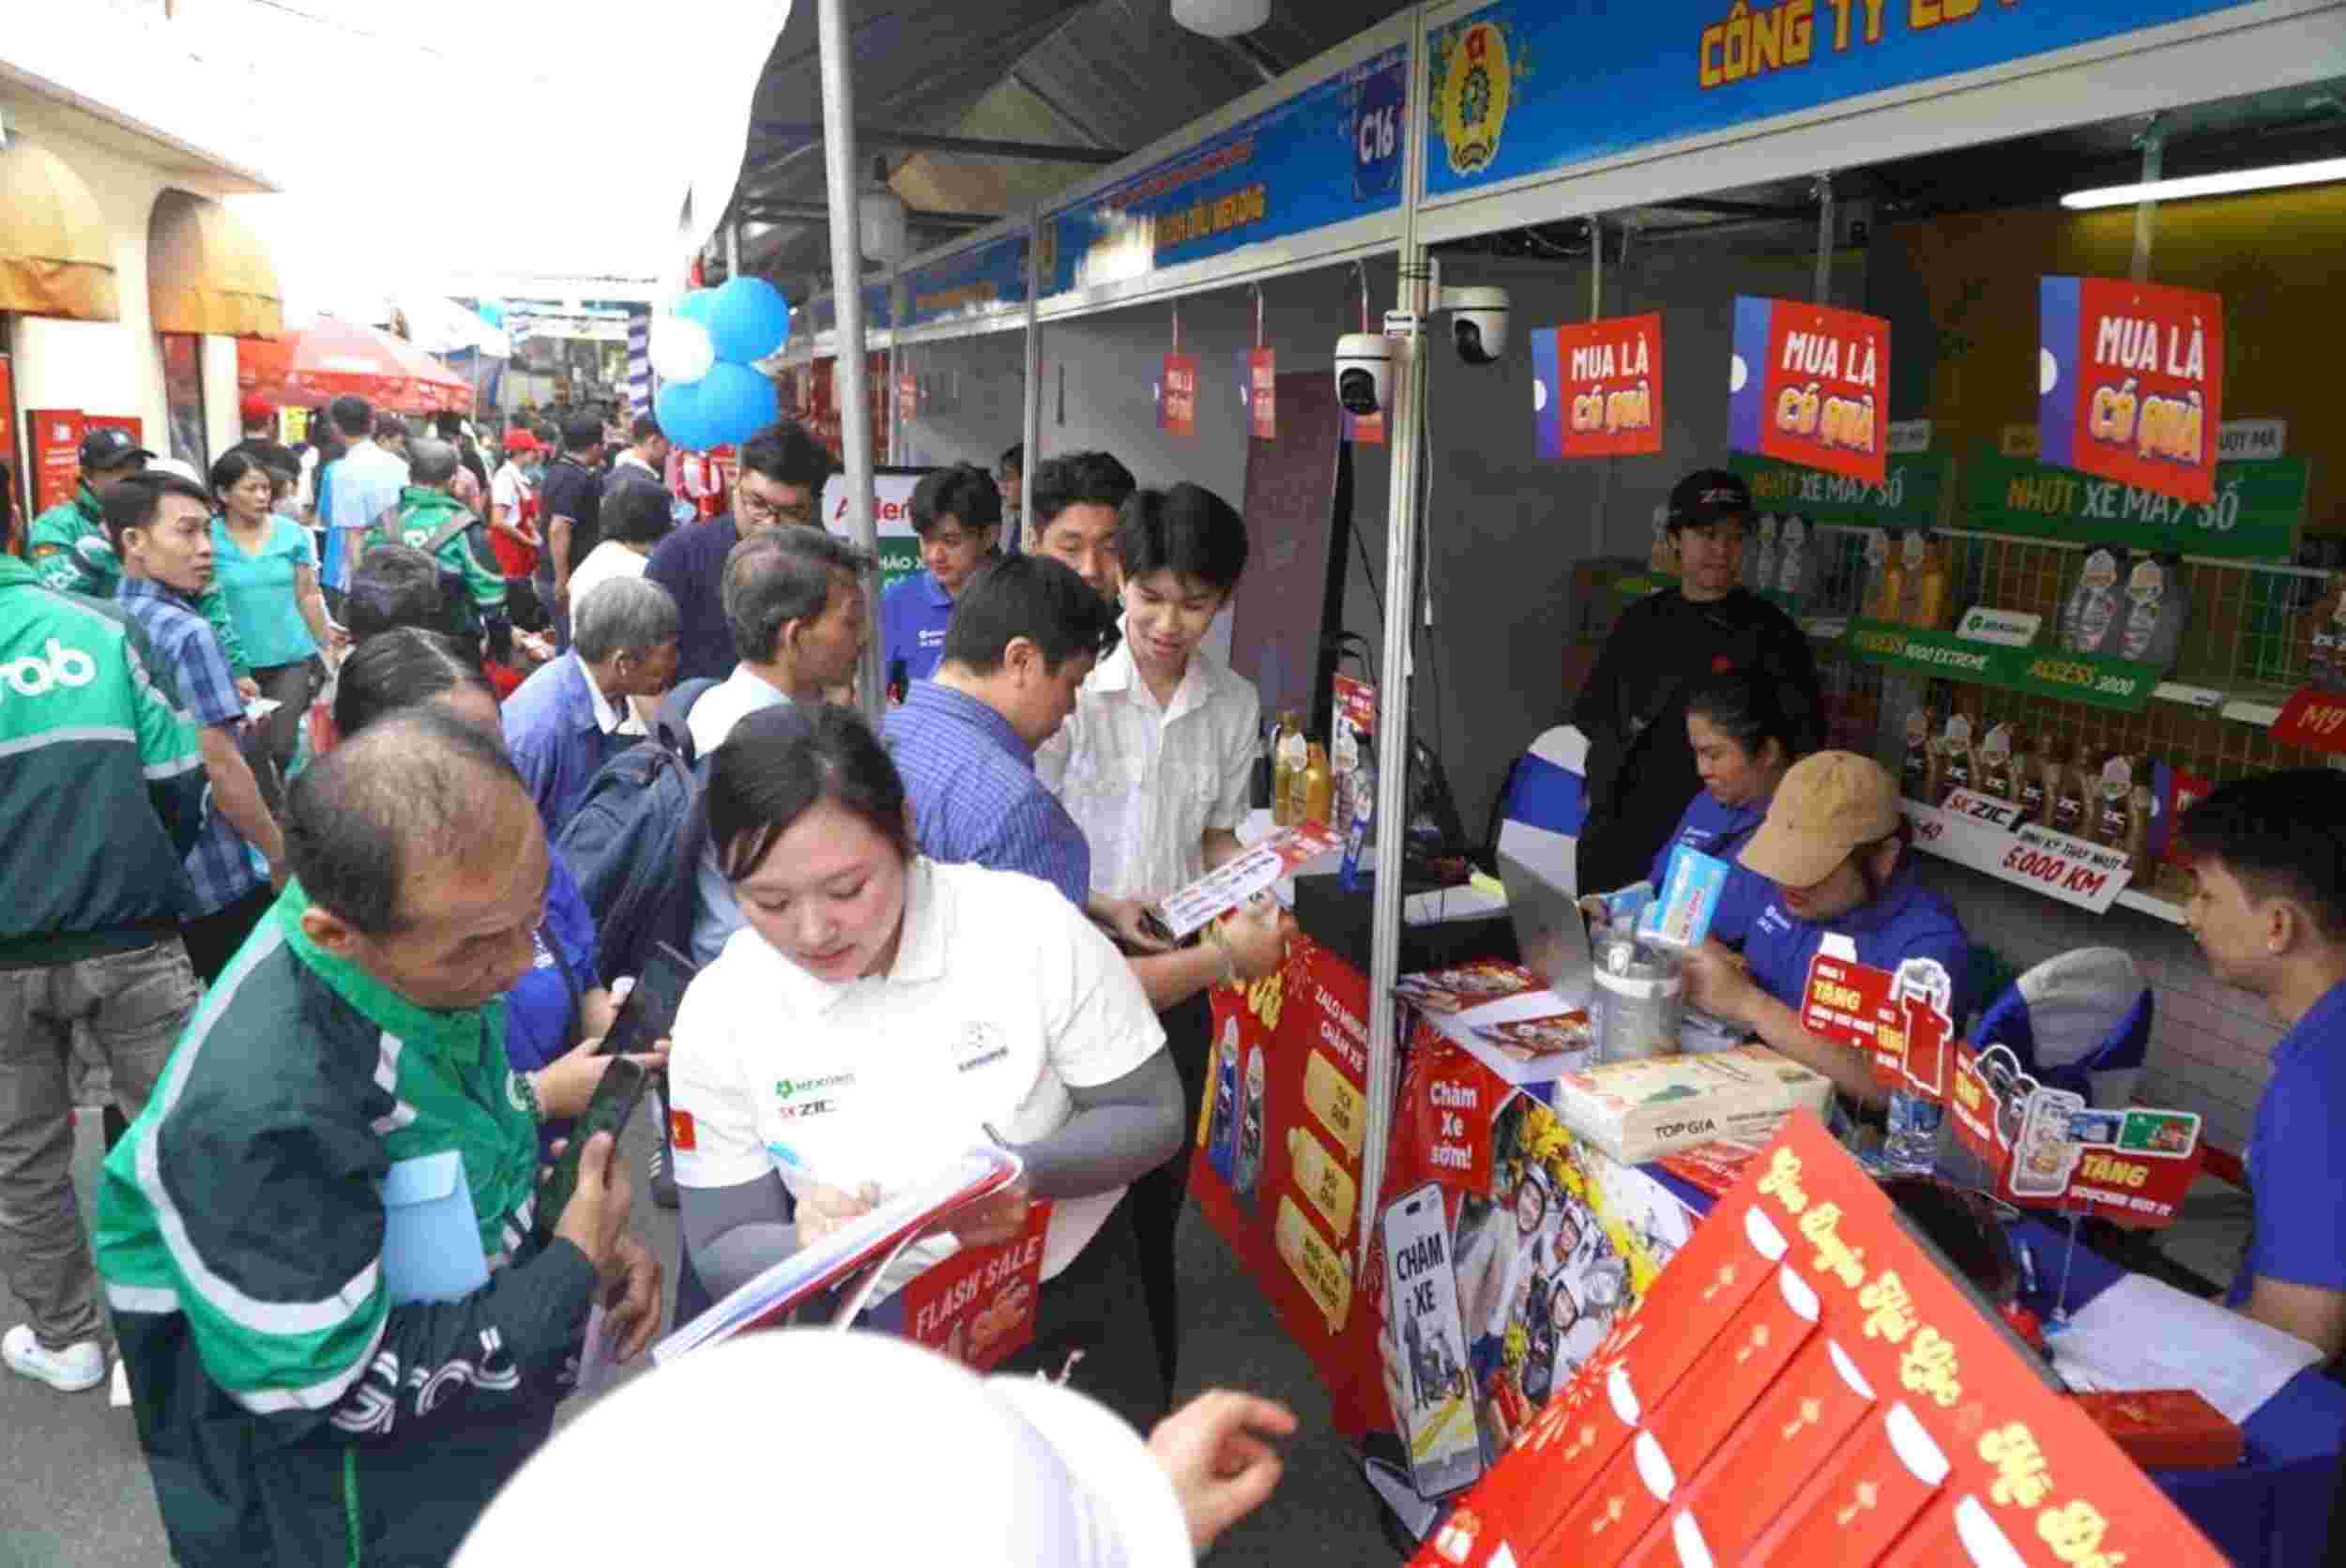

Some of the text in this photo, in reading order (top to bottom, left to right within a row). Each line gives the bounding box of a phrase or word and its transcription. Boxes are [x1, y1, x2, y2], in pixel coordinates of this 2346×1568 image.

[1700, 0, 1813, 89] CÔNG
[1359, 105, 1396, 164] C16
[1572, 333, 1649, 380] MUA LÀ
[1782, 331, 1877, 387] MUA LÀ
[2095, 315, 2205, 380] MUA LÀ
[2080, 480, 2119, 519] XE
[1971, 799, 2012, 829] ZIC
[2064, 860, 2110, 898] KM
[1441, 1110, 1464, 1136] Xe
[2079, 1153, 2148, 1188] TẶNG
[915, 1234, 1041, 1339] FLASH SALE
[1413, 1279, 1437, 1317] XE
